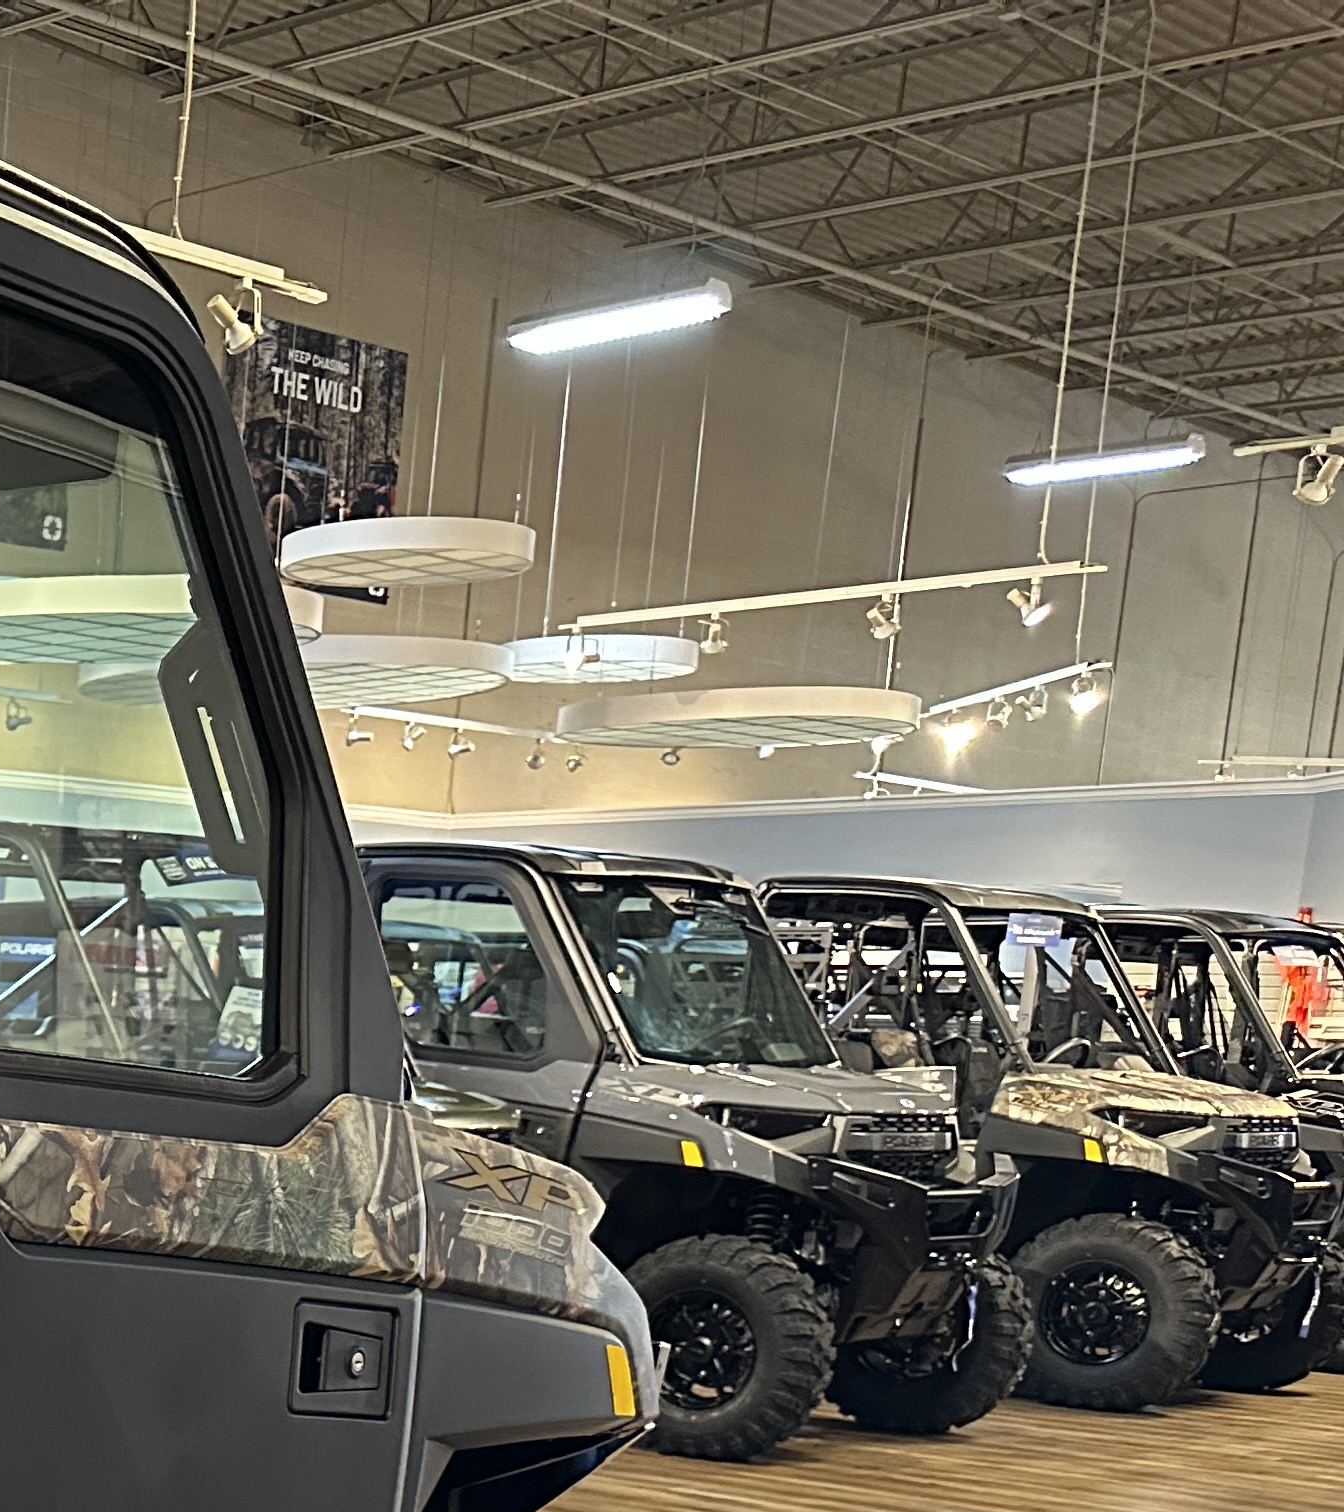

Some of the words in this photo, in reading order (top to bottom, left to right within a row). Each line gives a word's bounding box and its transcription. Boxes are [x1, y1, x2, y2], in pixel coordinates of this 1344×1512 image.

[312, 354, 350, 375] CHASING
[271, 366, 310, 401] THE
[315, 376, 362, 413] WILD
[0, 942, 54, 955] POLARIS
[436, 1147, 587, 1212] XP
[460, 1201, 572, 1257] 1000
